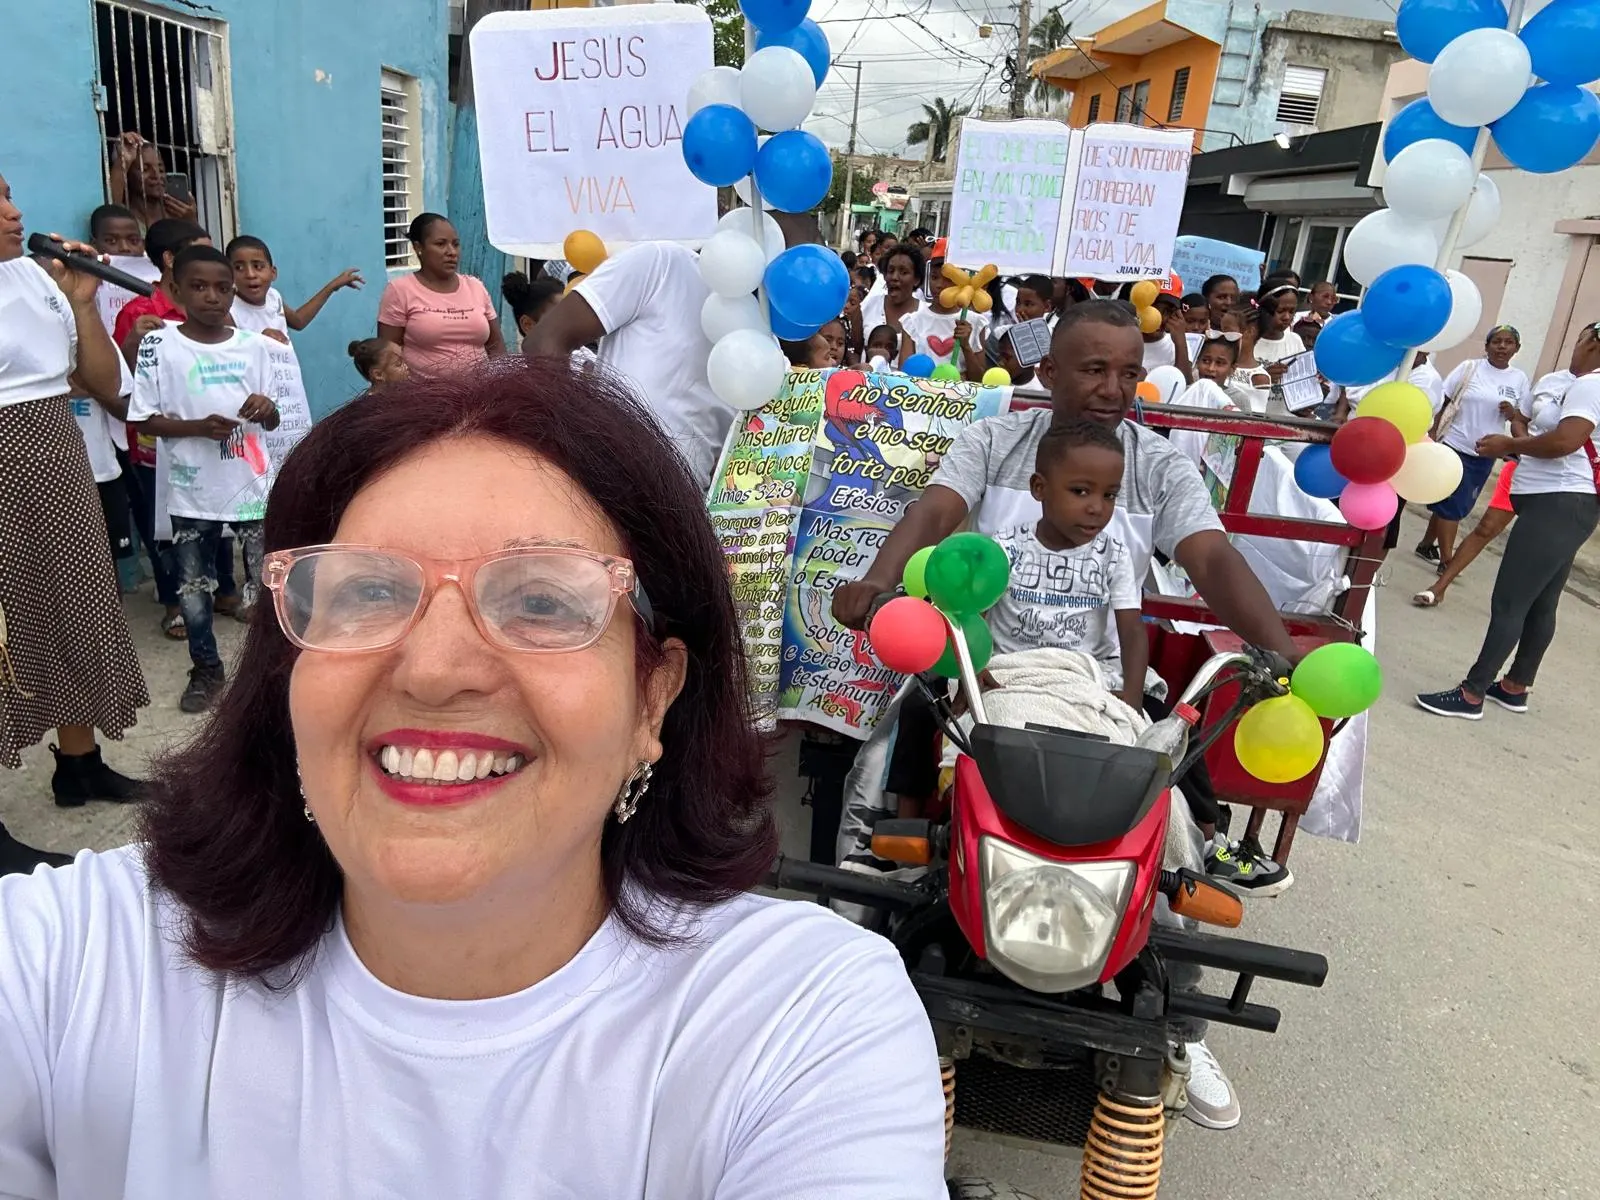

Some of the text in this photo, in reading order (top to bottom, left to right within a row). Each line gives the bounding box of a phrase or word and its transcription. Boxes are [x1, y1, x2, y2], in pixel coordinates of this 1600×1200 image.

[525, 105, 682, 153] EL AGUA
[1084, 145, 1104, 168] DE
[1107, 146, 1128, 169] SU
[961, 168, 985, 193] EN
[564, 176, 635, 214] VIVA
[1117, 212, 1139, 236] DE
[1072, 237, 1114, 263] AGUA
[1125, 241, 1156, 266] VIVA
[1116, 266, 1163, 275] JUAN 7:38
[788, 371, 821, 391] que
[849, 385, 976, 421] no Senhor
[854, 423, 954, 455] e no seu
[829, 452, 885, 480] forte
[754, 480, 795, 500] 32:8
[831, 487, 899, 515] Efésios
[713, 515, 762, 533] Porque
[808, 517, 854, 543] Mas
[724, 547, 770, 564] mundo
[806, 545, 869, 568] poder
[793, 571, 806, 584] o
[805, 624, 856, 648] sobre
[784, 645, 798, 660] e
[801, 648, 851, 672] serão
[806, 694, 848, 717] Atos
